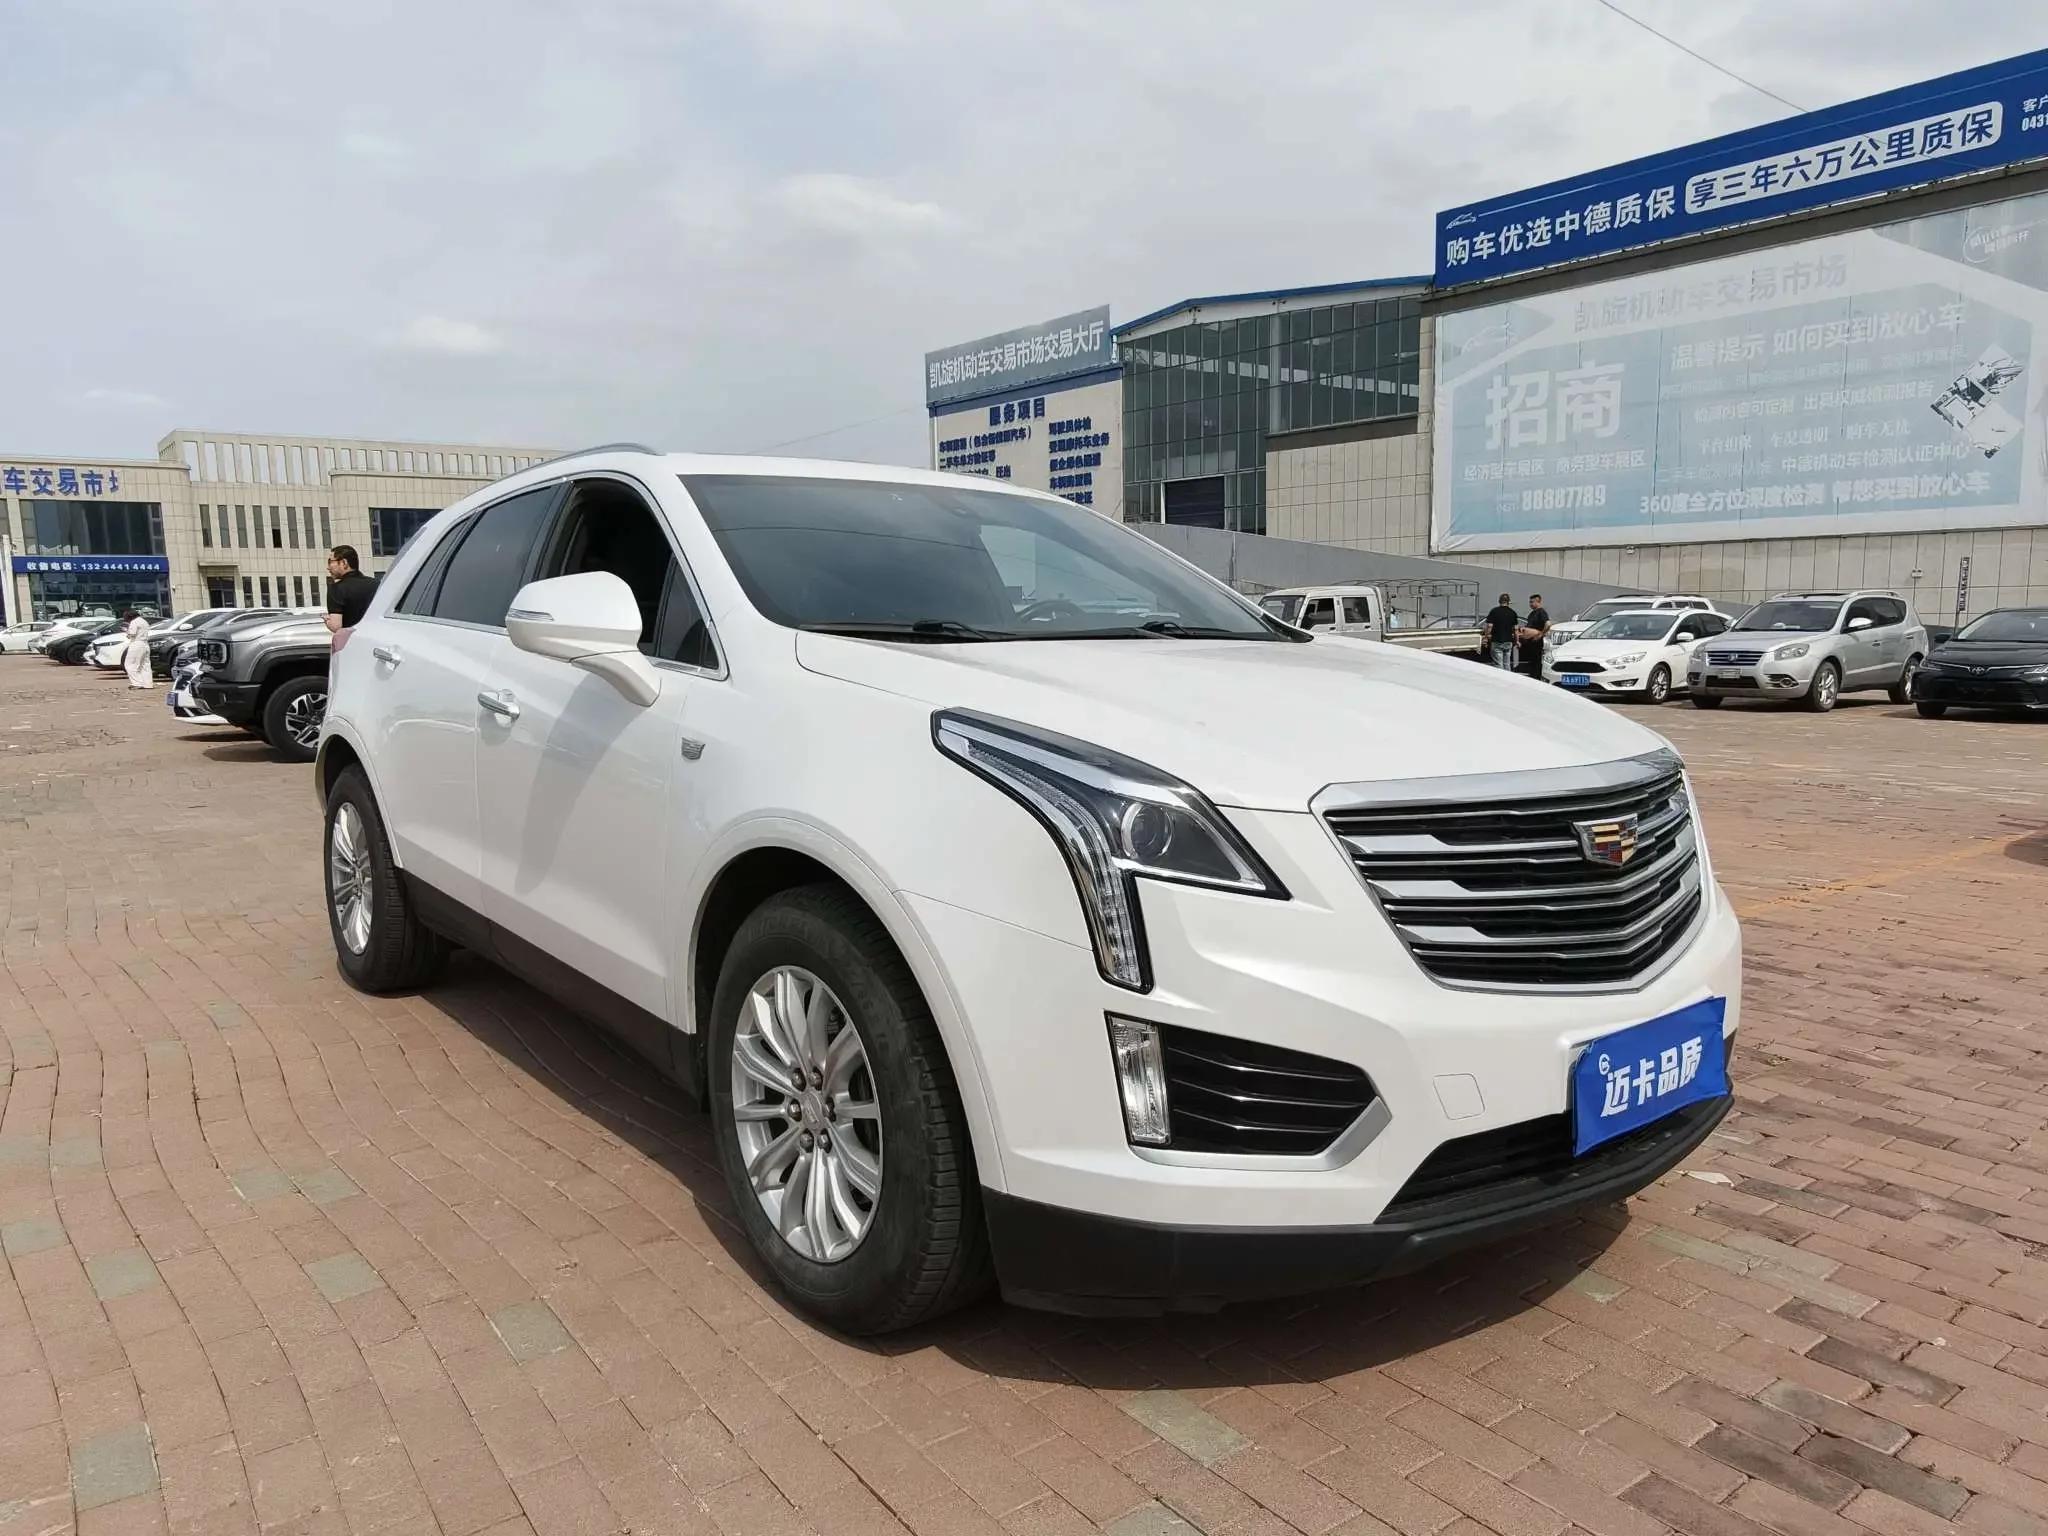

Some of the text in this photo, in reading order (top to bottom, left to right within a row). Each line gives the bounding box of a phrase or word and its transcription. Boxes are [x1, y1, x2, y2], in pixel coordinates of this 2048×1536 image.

[1690, 108, 1993, 209] 享三年六万公里质保
[1446, 185, 1675, 268] 购车优选中德质保
[929, 320, 1104, 389] 凯旋机动车交易市场交易大厅
[1484, 359, 1626, 450] 招商
[0, 466, 121, 498] 车交易市
[1600, 1036, 1703, 1117] 迈卡品质
